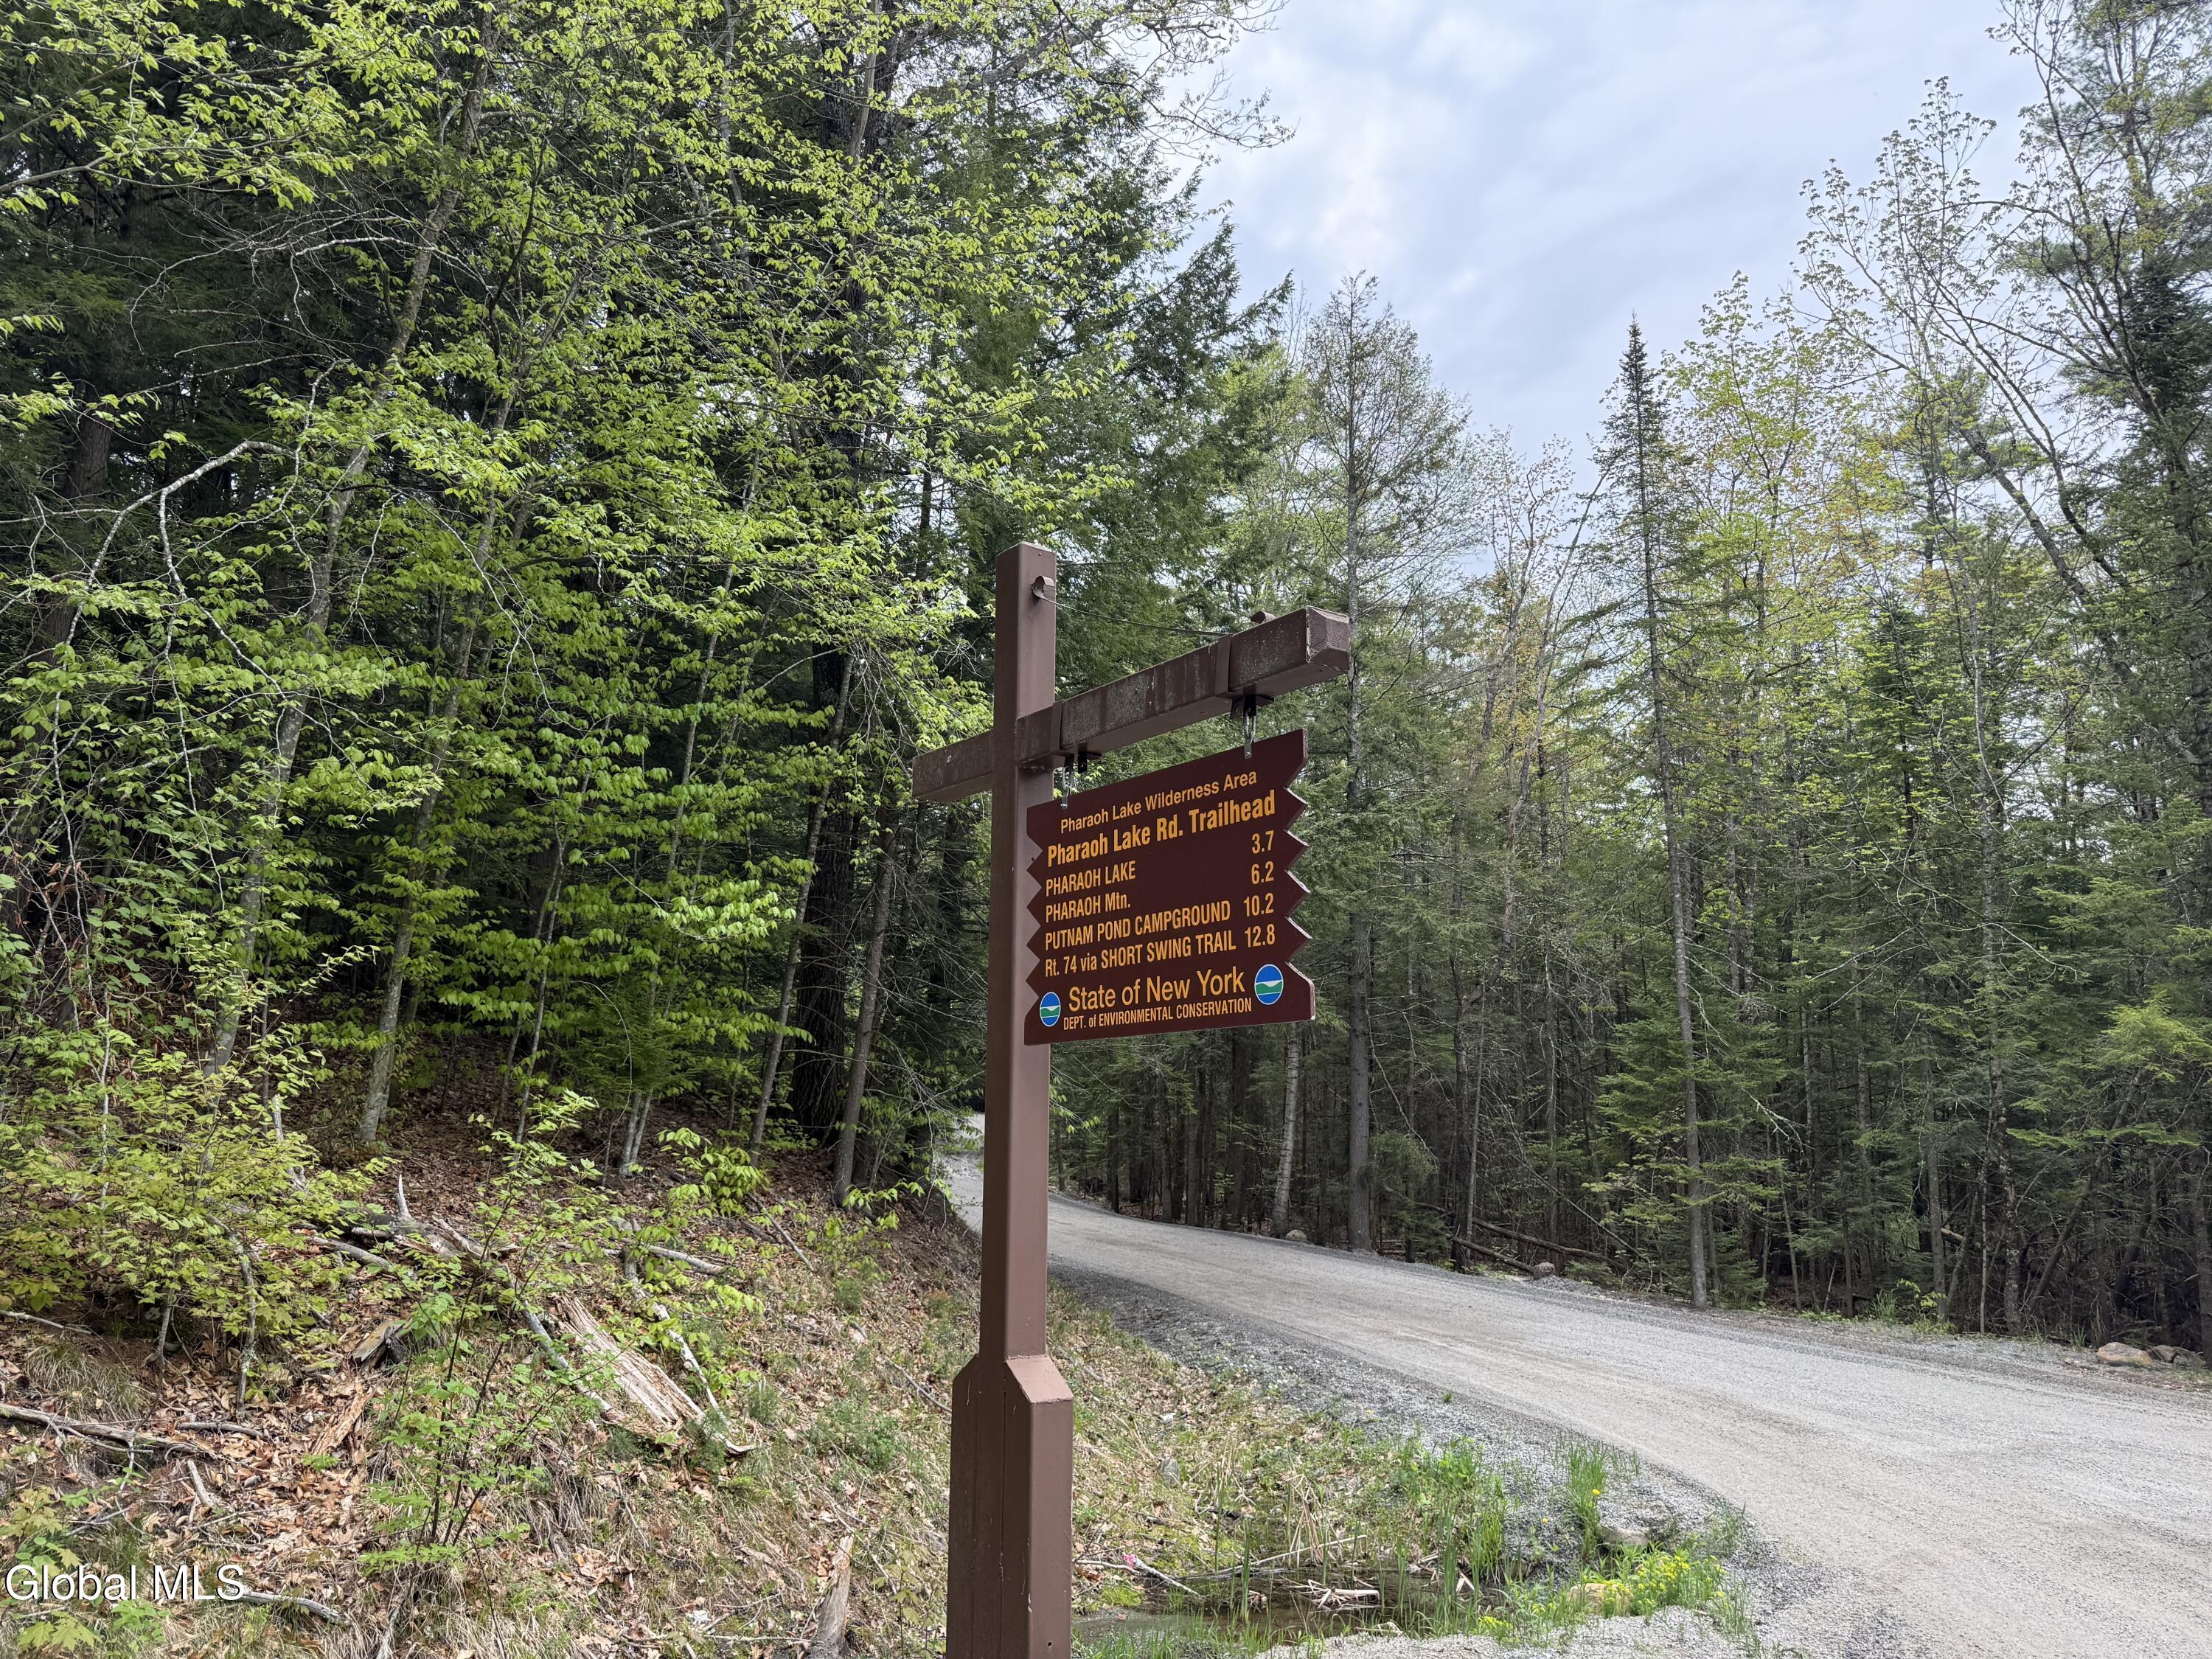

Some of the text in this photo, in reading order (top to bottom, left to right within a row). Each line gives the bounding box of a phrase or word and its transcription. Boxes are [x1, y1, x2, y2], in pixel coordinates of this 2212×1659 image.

[1048, 790, 1276, 867] Pharaoh Lake Rd. Trailhead
[1060, 771, 1257, 834] Pharaoh Lake Wilderness Area
[1046, 830, 1274, 897] PHARAOH LAKE 3.7
[1046, 861, 1274, 922] PHARAOH Mtn. 6.2
[1045, 892, 1274, 950] PUTNAM POND CAMPGROUND 10.2
[1045, 923, 1276, 977] Rt. 74 via SHORT SWING TRAIL 12.8
[1063, 997, 1252, 1030] DEPT. of ENVIRONMENTAL CONSERVATION
[1068, 966, 1245, 1012] State of New York
